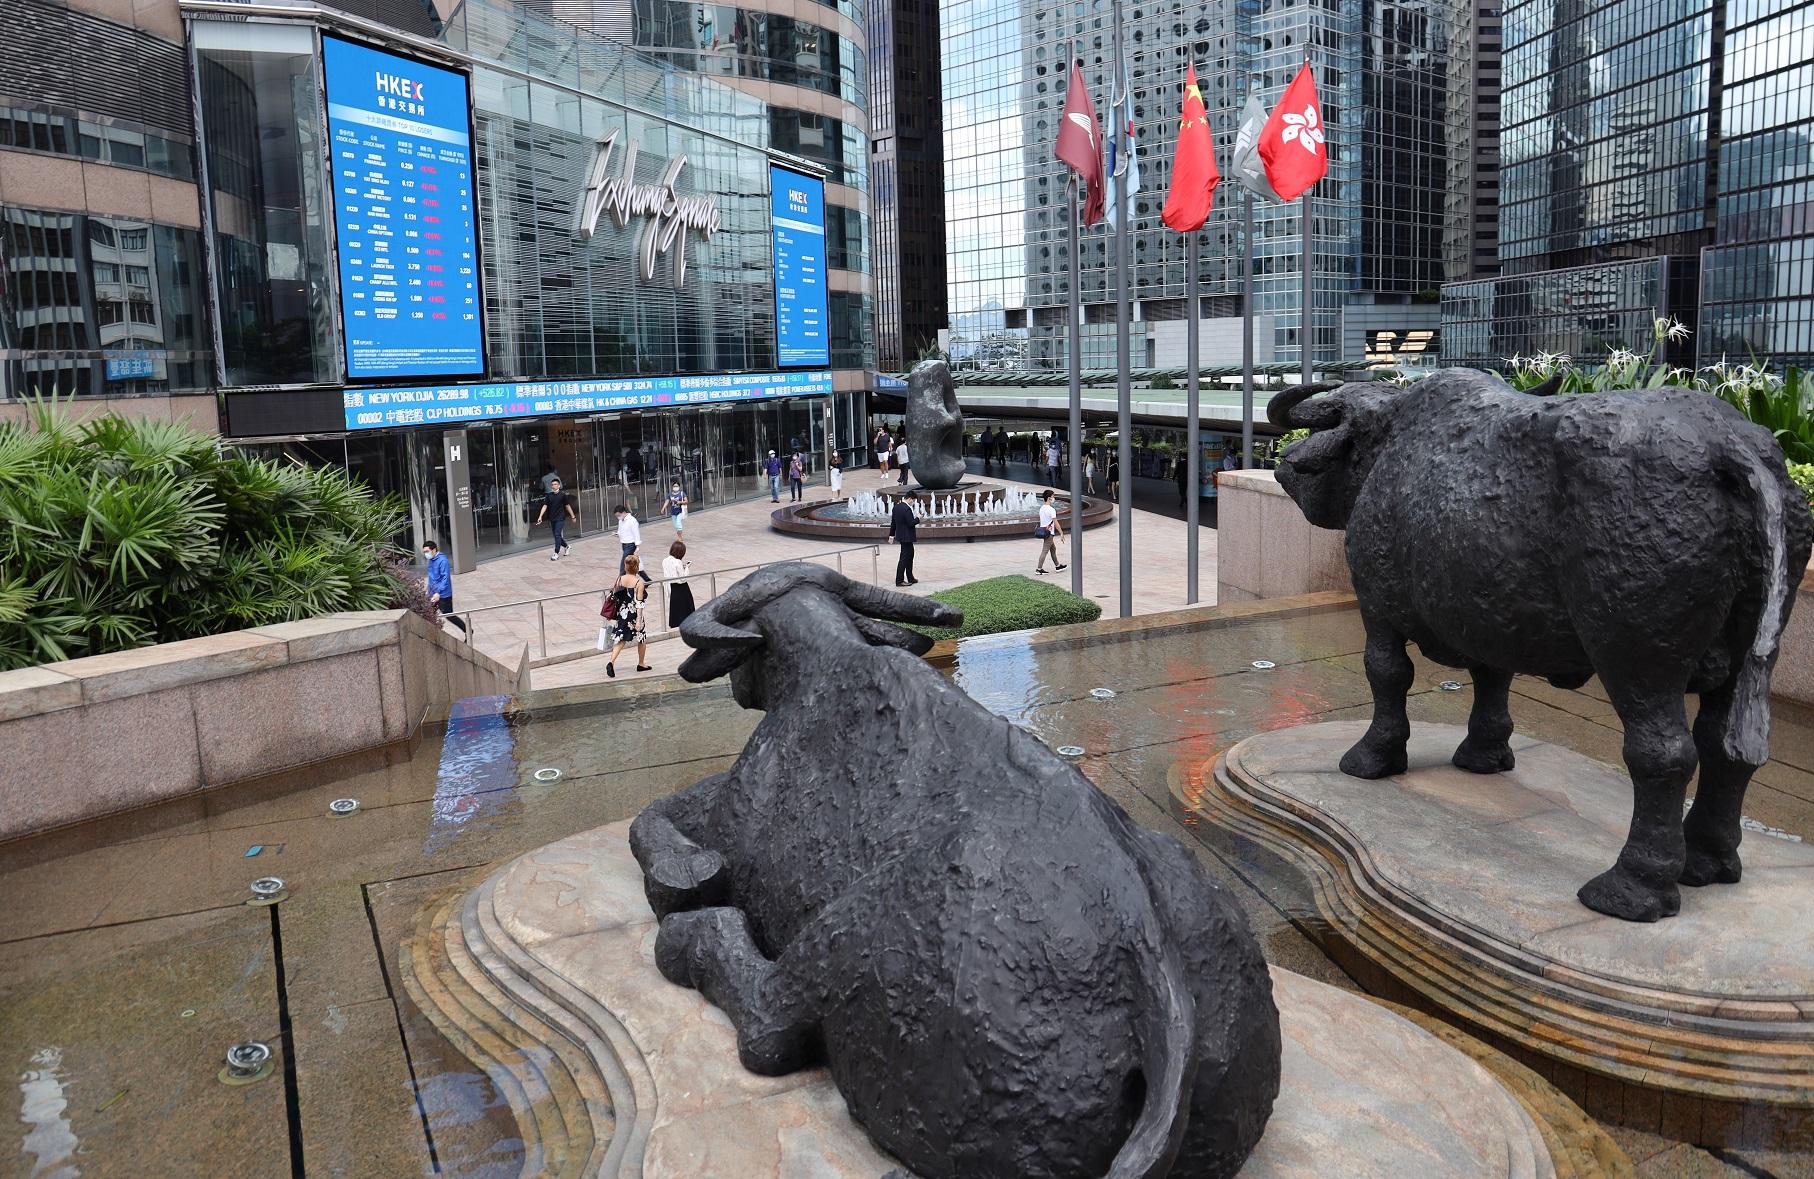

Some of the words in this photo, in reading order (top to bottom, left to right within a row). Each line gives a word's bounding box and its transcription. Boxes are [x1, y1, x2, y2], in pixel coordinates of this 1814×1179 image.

[376, 71, 423, 102] HKEX
[789, 190, 807, 205] HKEX
[369, 393, 390, 404] NEW
[391, 392, 415, 402] YORK
[416, 391, 434, 401] DJIA
[426, 409, 442, 419] CLP
[444, 406, 482, 417] HOLDINGS
[485, 404, 503, 414] 76.75
[627, 396, 638, 404] GAS
[451, 446, 461, 461] H
